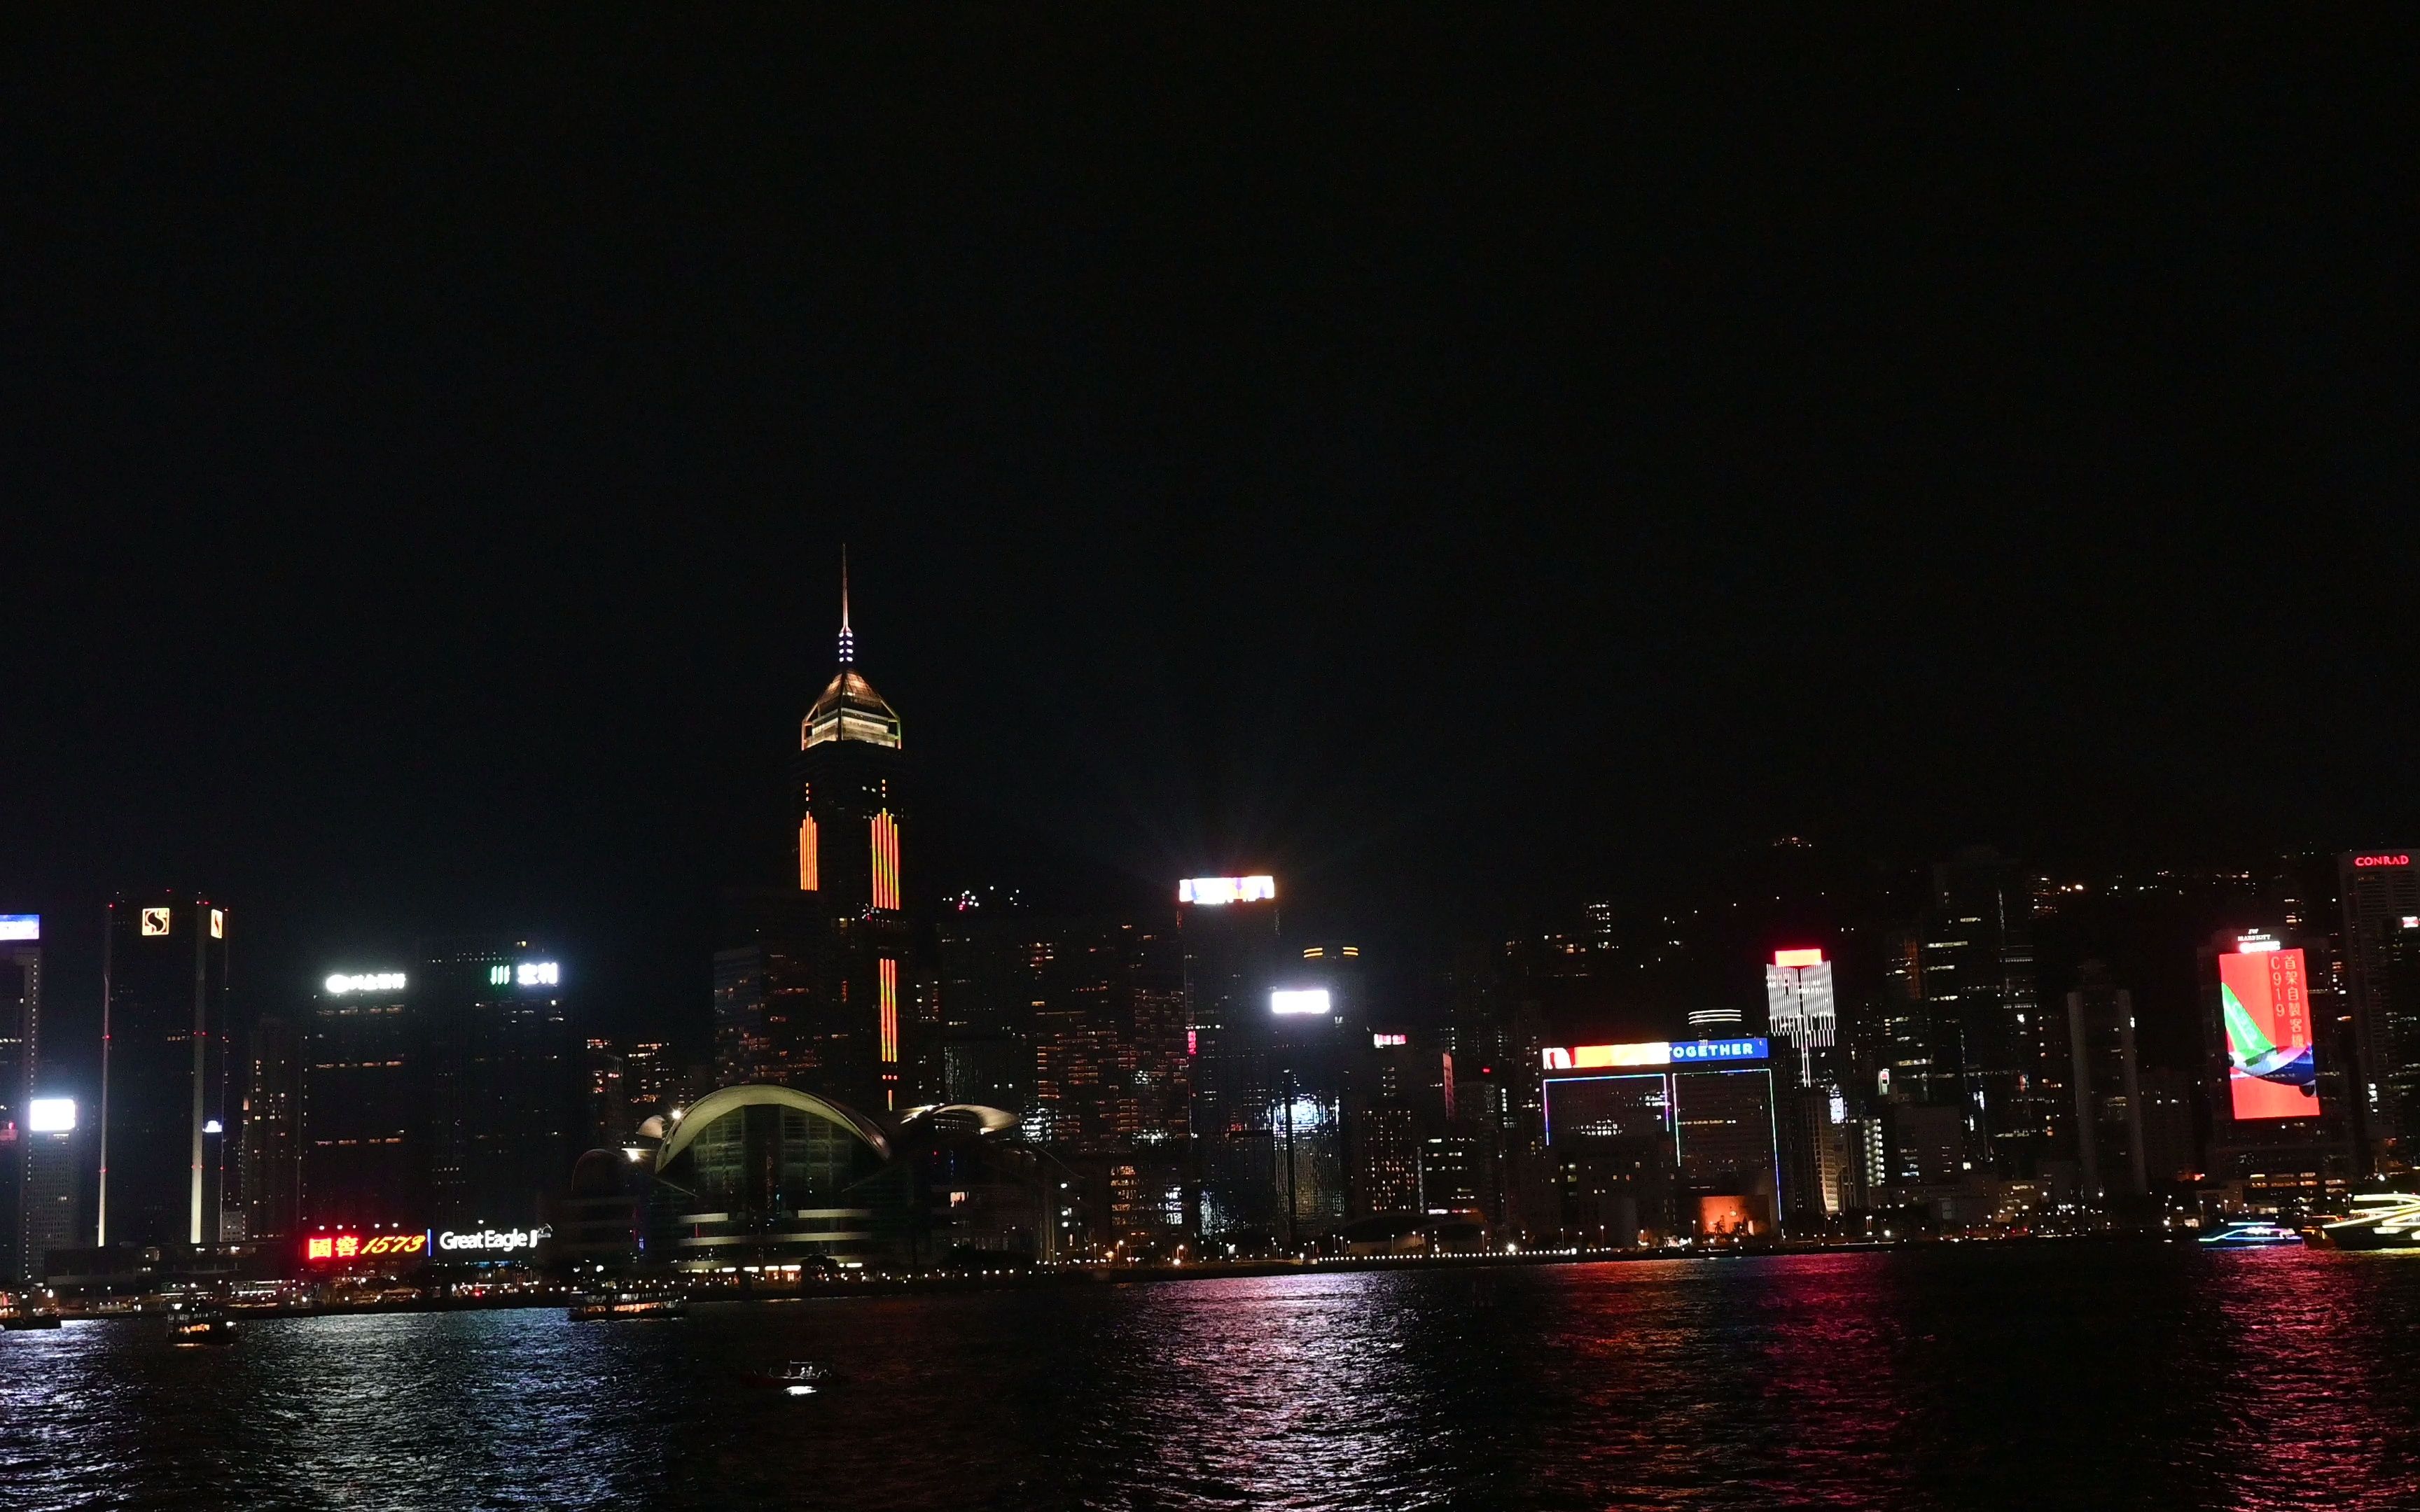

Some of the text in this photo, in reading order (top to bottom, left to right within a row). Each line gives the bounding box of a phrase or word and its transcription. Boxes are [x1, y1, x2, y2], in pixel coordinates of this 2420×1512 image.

[2354, 855, 2409, 867] CONRAD
[2270, 955, 2286, 1017] C919
[360, 1235, 426, 1254] 1573
[440, 1228, 528, 1252] Great Eagle
